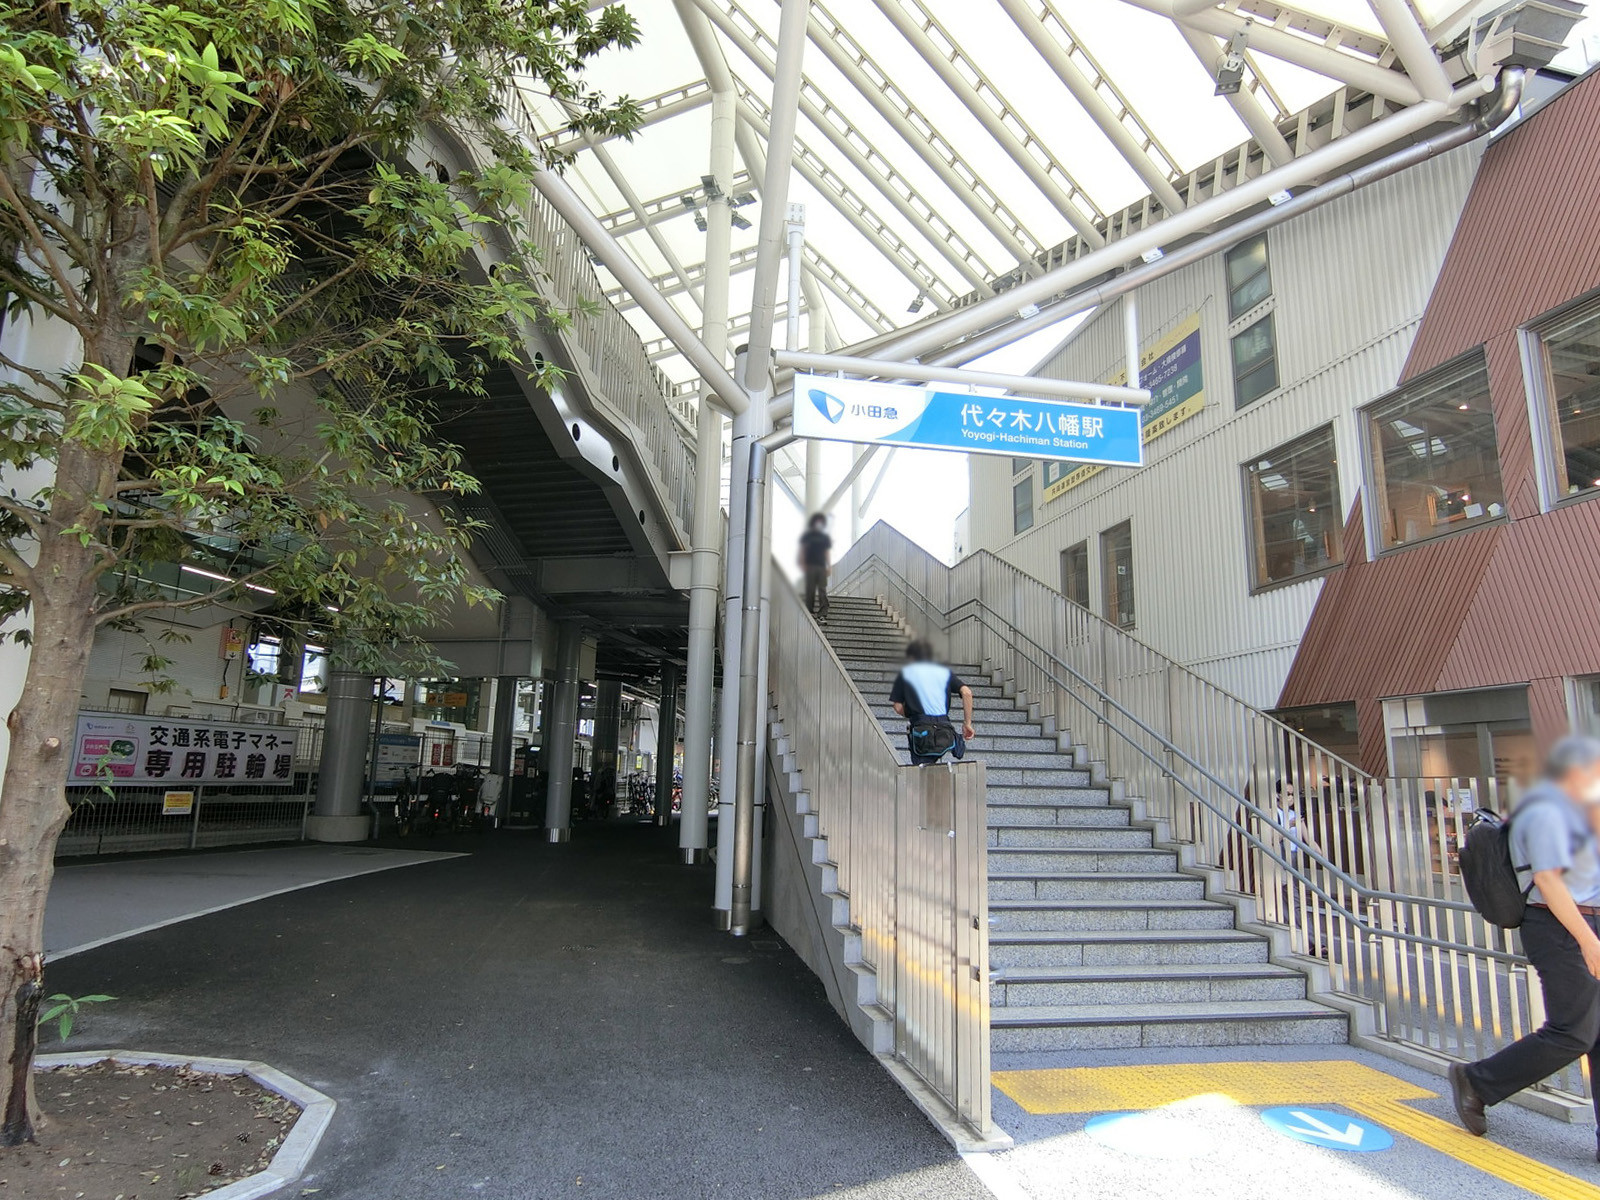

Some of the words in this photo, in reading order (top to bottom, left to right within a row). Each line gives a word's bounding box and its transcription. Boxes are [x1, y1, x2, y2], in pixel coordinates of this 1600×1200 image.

[850, 404, 899, 421] 小田急
[960, 402, 1105, 439] 代々木八幡駅
[961, 428, 1051, 447] Yoyogi-Hachiman
[1052, 437, 1089, 450] Station
[149, 725, 294, 751] 交通系電子マネー
[144, 749, 293, 779] 専用駐輪場
